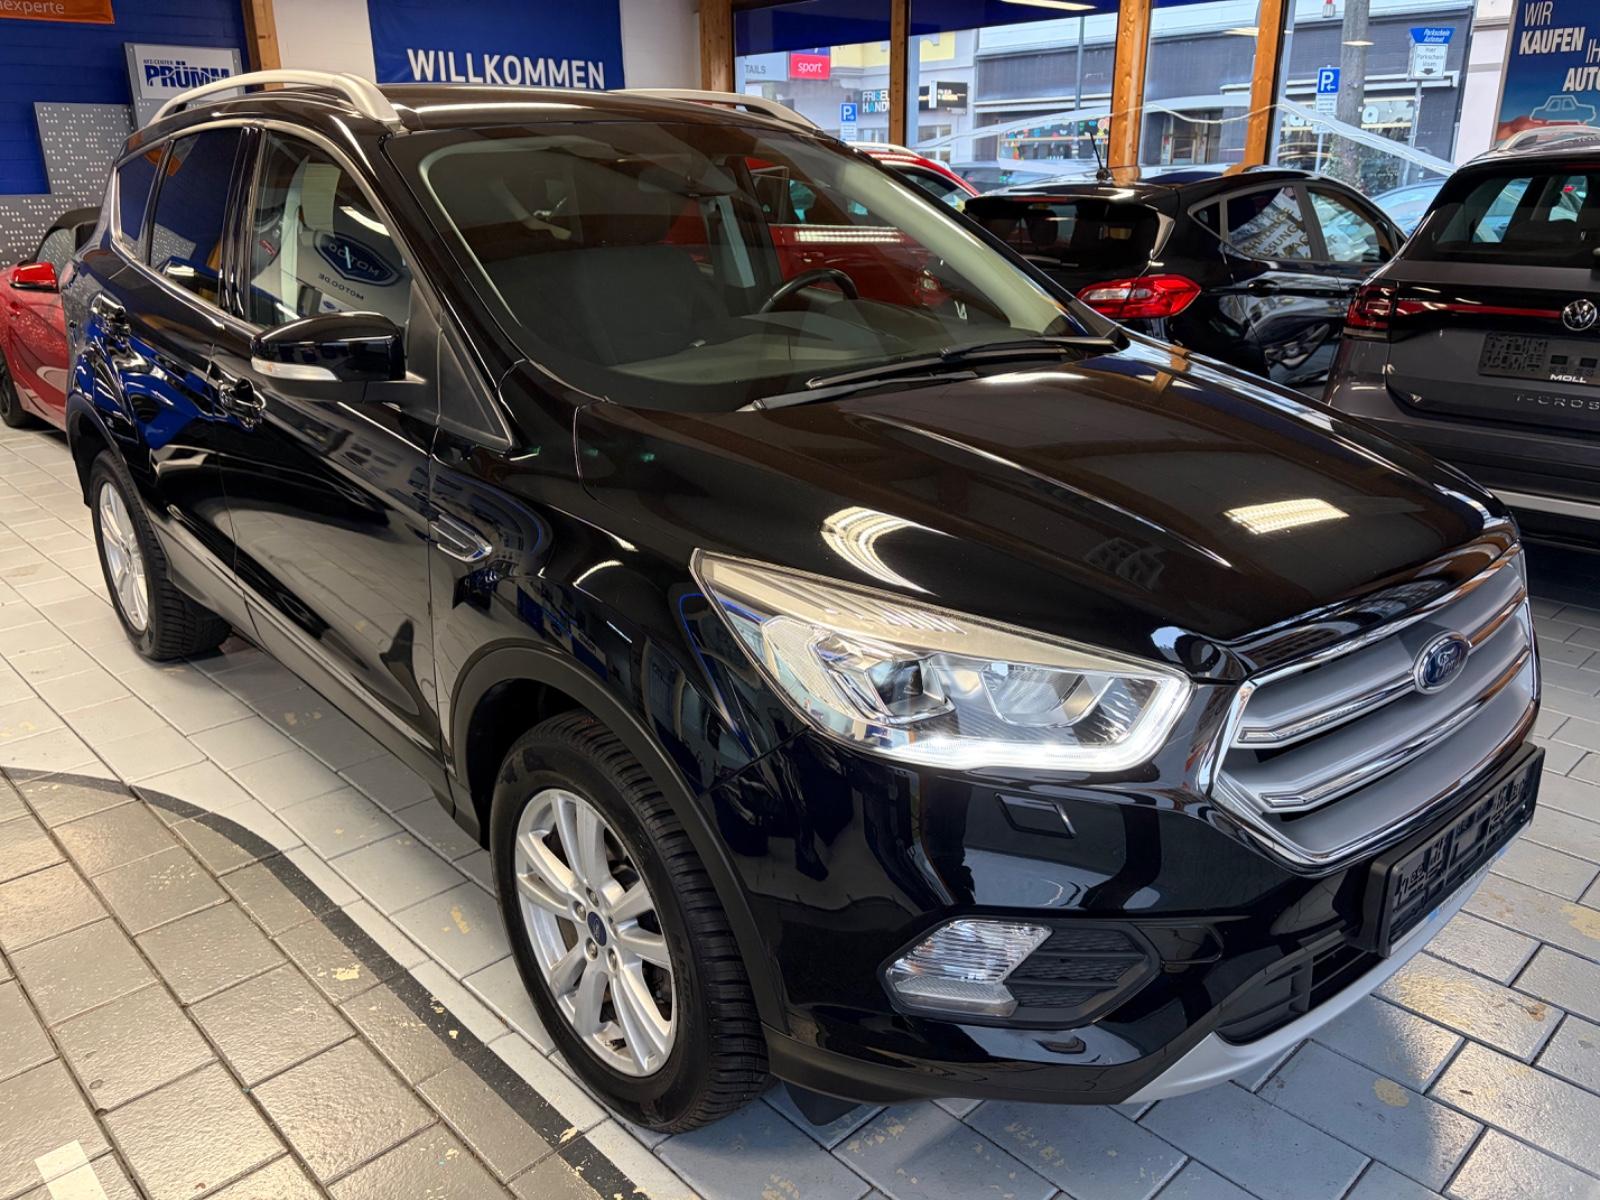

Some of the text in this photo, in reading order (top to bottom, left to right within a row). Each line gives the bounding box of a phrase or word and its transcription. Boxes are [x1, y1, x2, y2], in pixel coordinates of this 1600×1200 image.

[1524, 1, 1554, 27] WIR
[1519, 26, 1586, 55] KAUFEN
[407, 48, 605, 89] WILLKOMMEN
[797, 61, 823, 74] sport
[1320, 70, 1335, 92] P
[843, 105, 853, 121] P
[1550, 373, 1587, 384] MOLL
